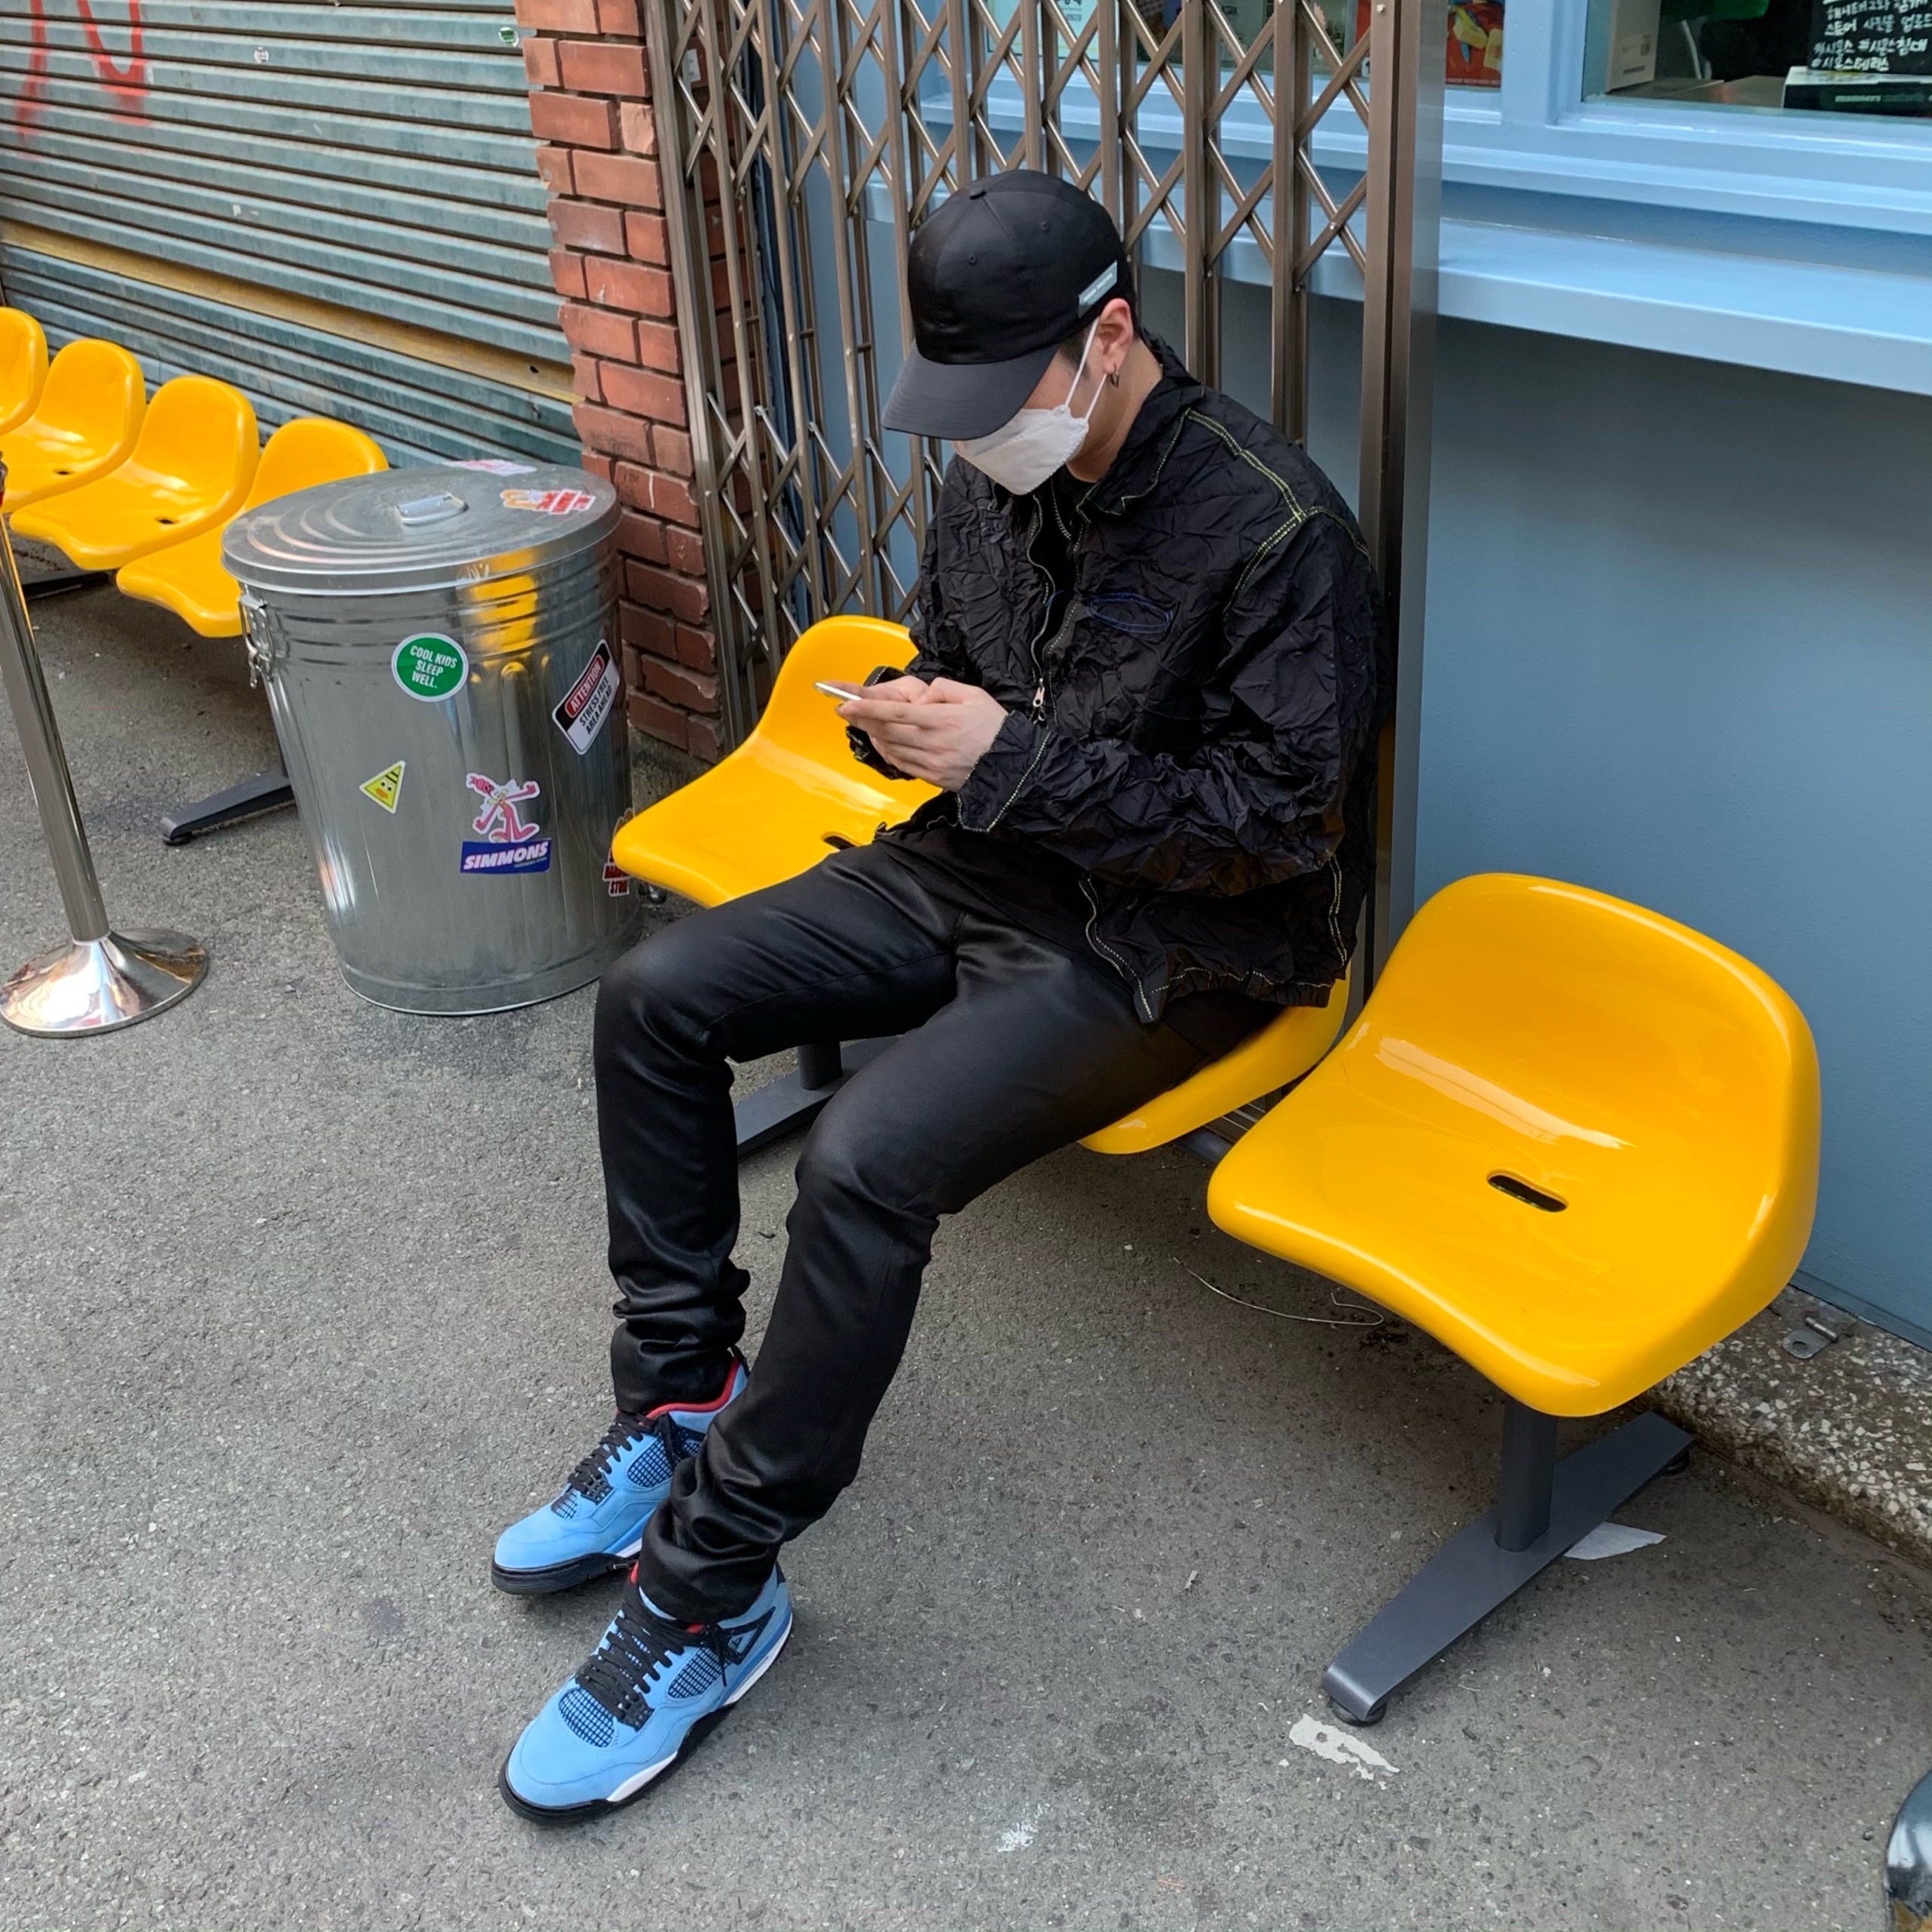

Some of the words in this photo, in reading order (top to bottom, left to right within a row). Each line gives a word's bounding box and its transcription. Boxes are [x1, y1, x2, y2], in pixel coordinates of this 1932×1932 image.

[410, 645, 434, 663] COOL
[435, 653, 457, 669] KIDS
[415, 659, 444, 676] SLEEP
[411, 671, 438, 689] WELL.
[570, 662, 602, 712] ATTENTION
[579, 697, 600, 727] STRESS
[598, 675, 610, 699] FREE
[586, 713, 600, 735] AREA
[598, 685, 613, 712] AHEAD
[463, 841, 549, 870] SIMMONS
